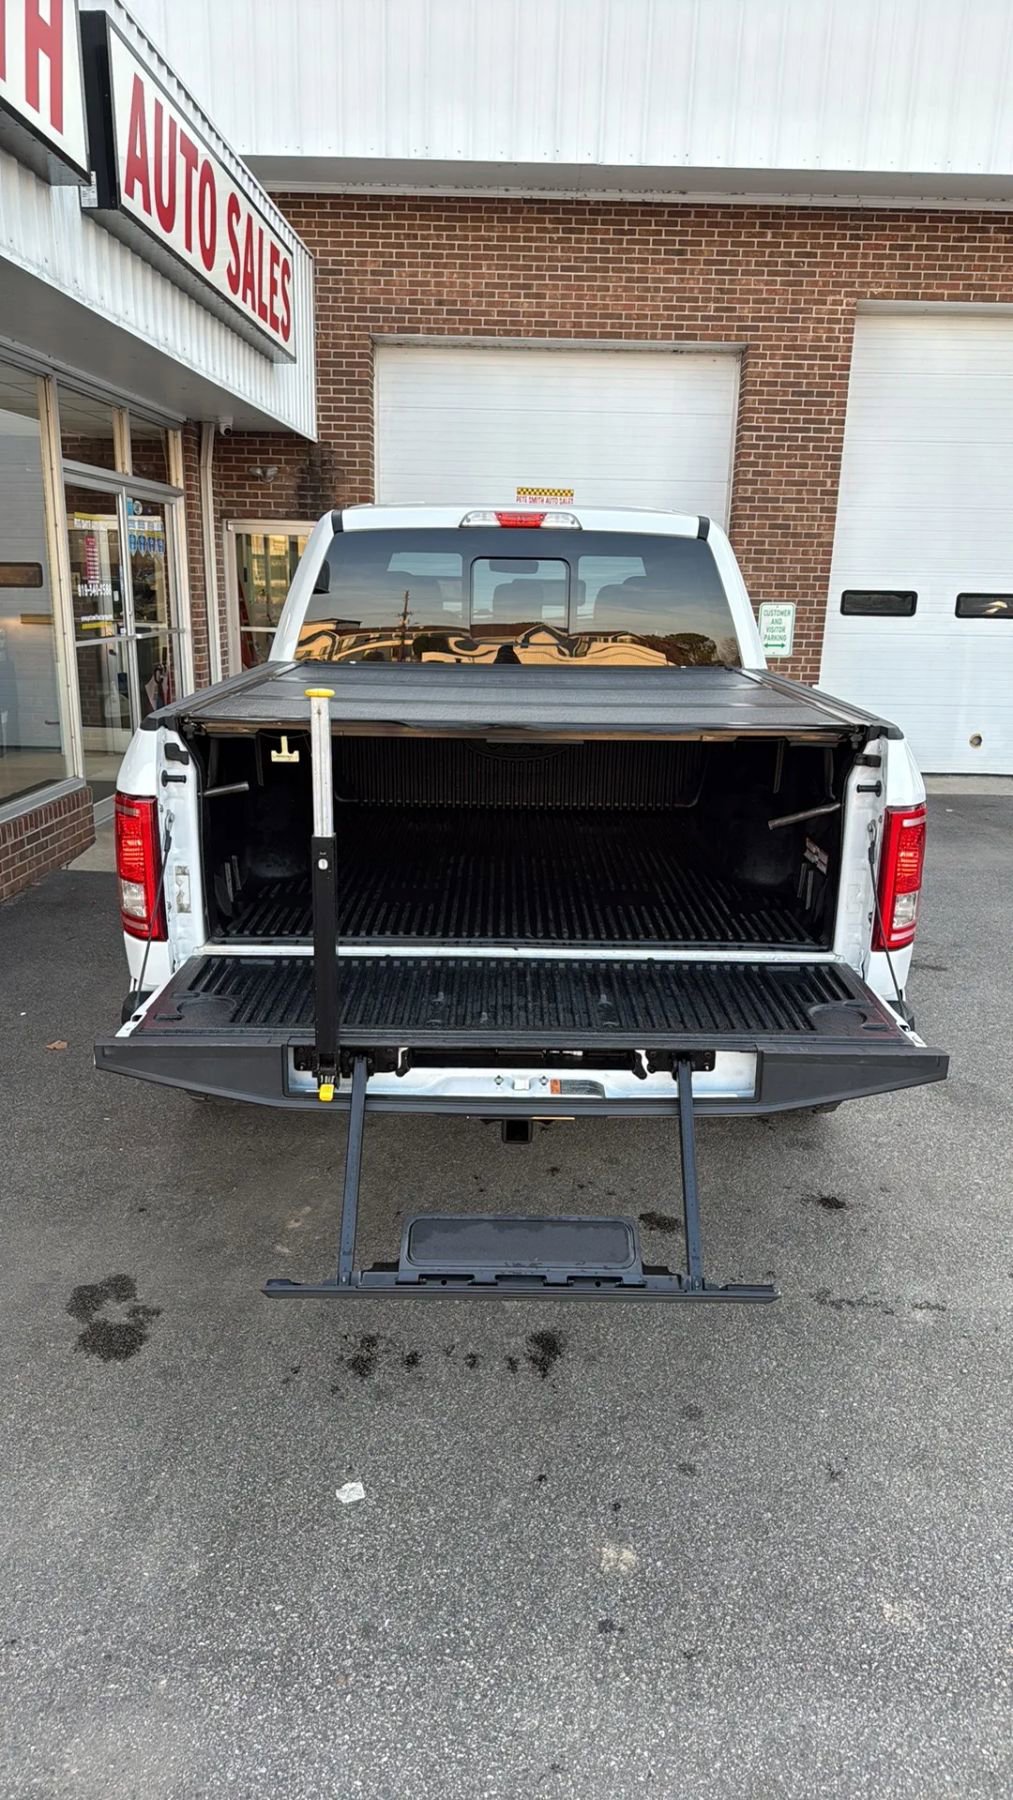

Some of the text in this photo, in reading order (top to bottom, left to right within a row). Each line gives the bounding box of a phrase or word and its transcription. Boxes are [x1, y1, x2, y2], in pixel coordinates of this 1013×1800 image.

[124, 72, 292, 342] AUTO SALES
[528, 496, 545, 504] SMITH
[559, 497, 574, 505] SALES
[763, 609, 791, 617] CUSTOMER
